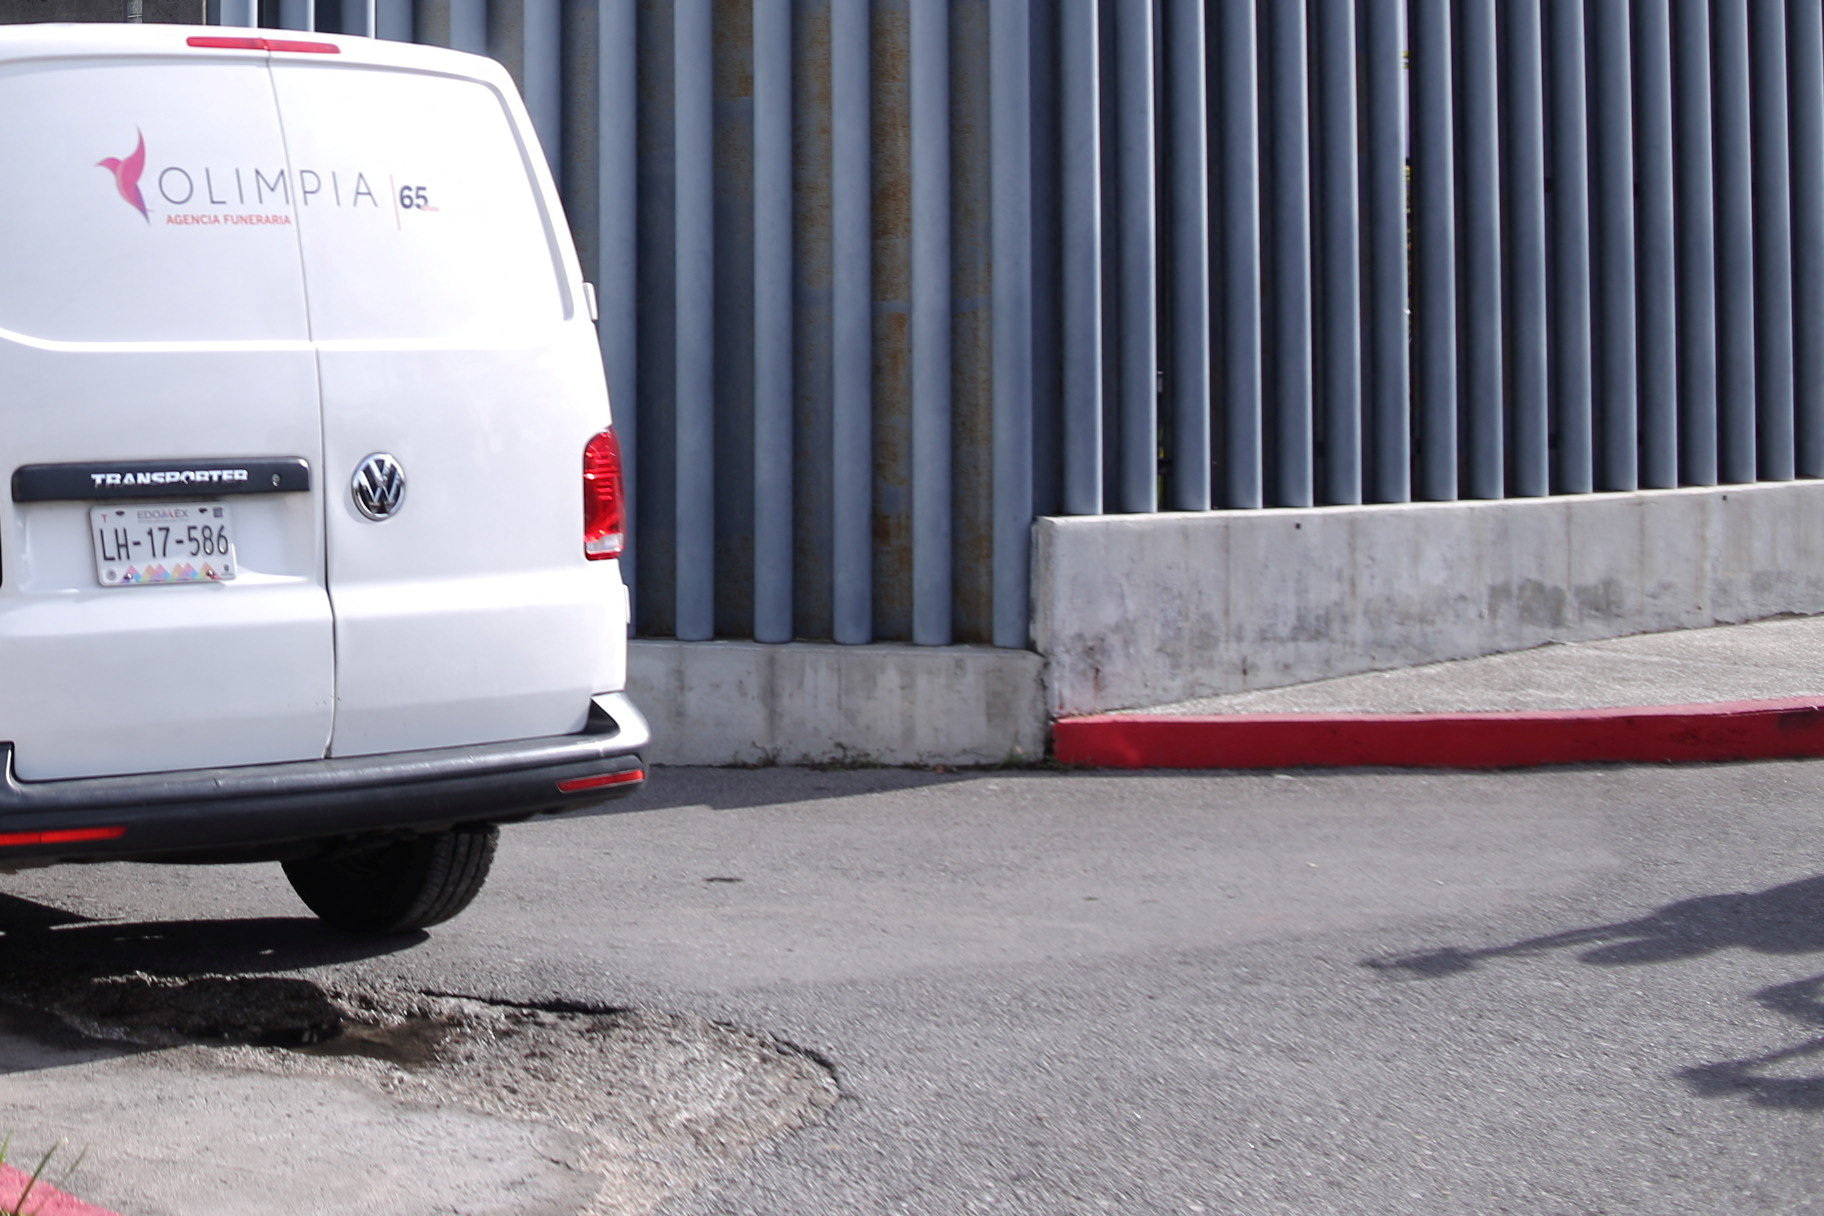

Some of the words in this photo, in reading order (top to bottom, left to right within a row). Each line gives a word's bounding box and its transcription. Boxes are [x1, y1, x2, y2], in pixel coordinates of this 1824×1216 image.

[158, 166, 379, 208] OLIMPIA
[166, 214, 220, 225] AGENCIA
[223, 214, 292, 225] FUNERARIA
[90, 469, 249, 488] TRANSPORTER
[100, 525, 229, 562] LH-17-586
